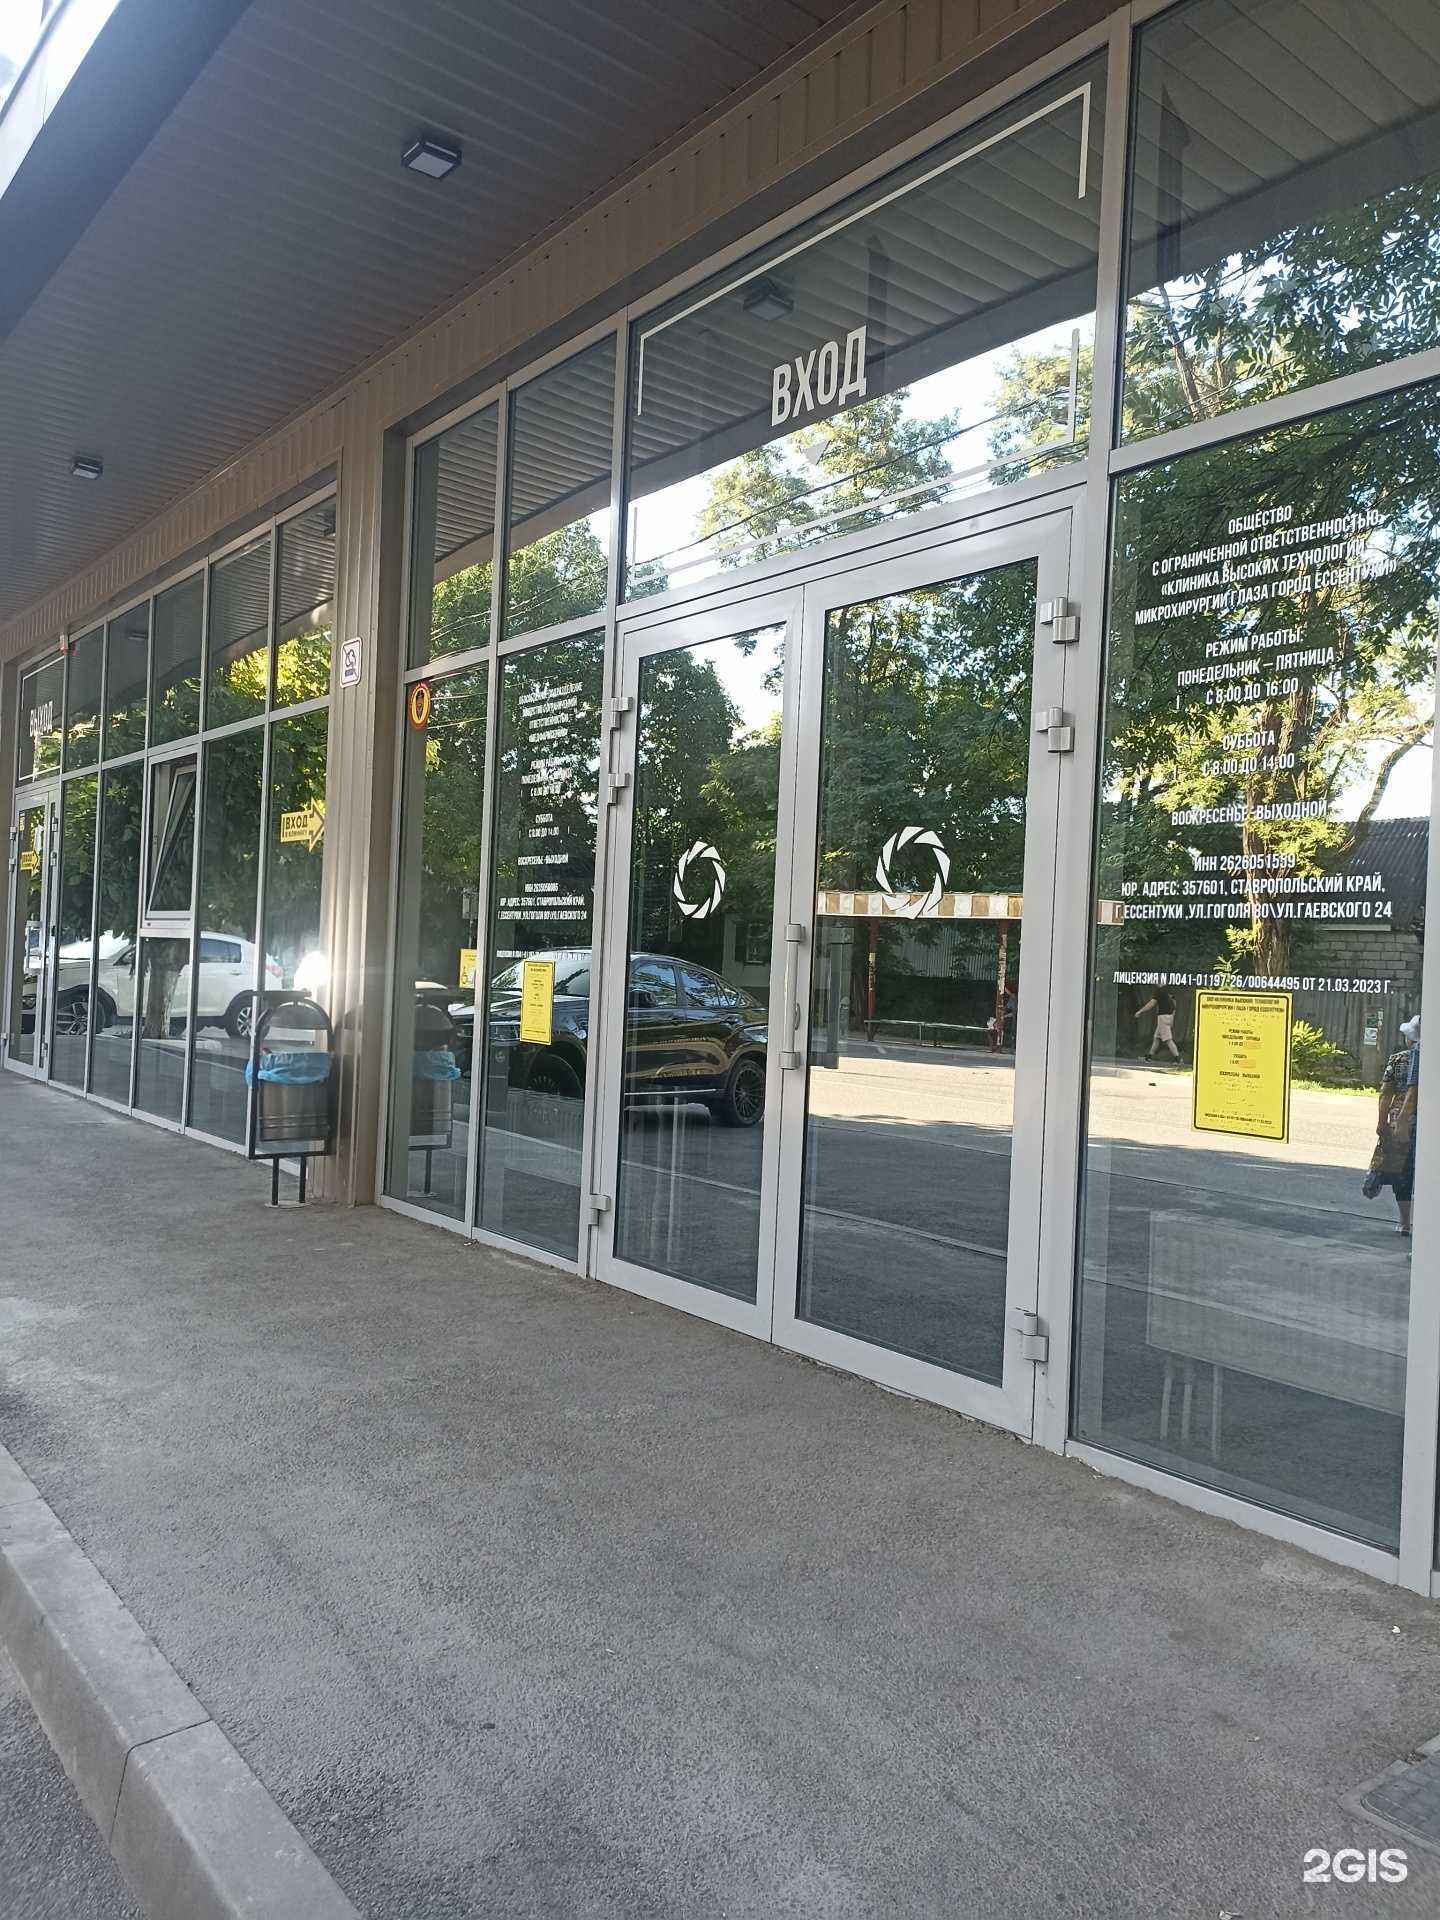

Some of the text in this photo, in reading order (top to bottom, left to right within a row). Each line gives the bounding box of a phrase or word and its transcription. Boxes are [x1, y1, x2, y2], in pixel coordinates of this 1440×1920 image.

[771, 325, 867, 427] ВХОД
[1228, 505, 1292, 534] ОБЩЕСТВО
[1152, 509, 1379, 577] С ОГРАНИЧЕННОЙ ОТВЕТСТВЕННОСТЬЮ
[1161, 571, 1220, 596] «КЛИНИКА
[1222, 557, 1279, 585] ВЫСОКИХ
[1135, 592, 1228, 626] МИКРОХИРУРГИИ
[1229, 583, 1270, 606] ГЛАЗА
[1271, 574, 1312, 599] ГОРОД
[1205, 627, 1304, 658] РЕЖИМ РАБОТЫ:
[1177, 657, 1261, 687] ПОНЕДЕЛЬНИК
[1275, 646, 1335, 672] ПЯТНИЦА
[1206, 689, 1214, 705] С
[1244, 683, 1261, 702] ДО
[1222, 729, 1276, 751] СУББОТА
[1203, 761, 1210, 777] С
[1240, 756, 1257, 774] ДО
[285, 814, 308, 830] ВХОД
[1171, 805, 1248, 826] ВОСКРЕСЕНЬЕ
[1194, 855, 1218, 872] ИНН
[1121, 882, 1140, 897] ЮР.
[1142, 881, 1180, 898] АДРЕС:
[1230, 873, 1343, 895] СТАВРОПОЛЬСКИЙ
[1346, 871, 1386, 893] КРАЙ,
[1374, 901, 1393, 918] 24
[1113, 971, 1158, 985] ЛИЦЕНЗИЯ
[1302, 977, 1316, 990] ОТ
[1318, 978, 1381, 994] 21.03.2023
[1384, 979, 1395, 995] Г.
